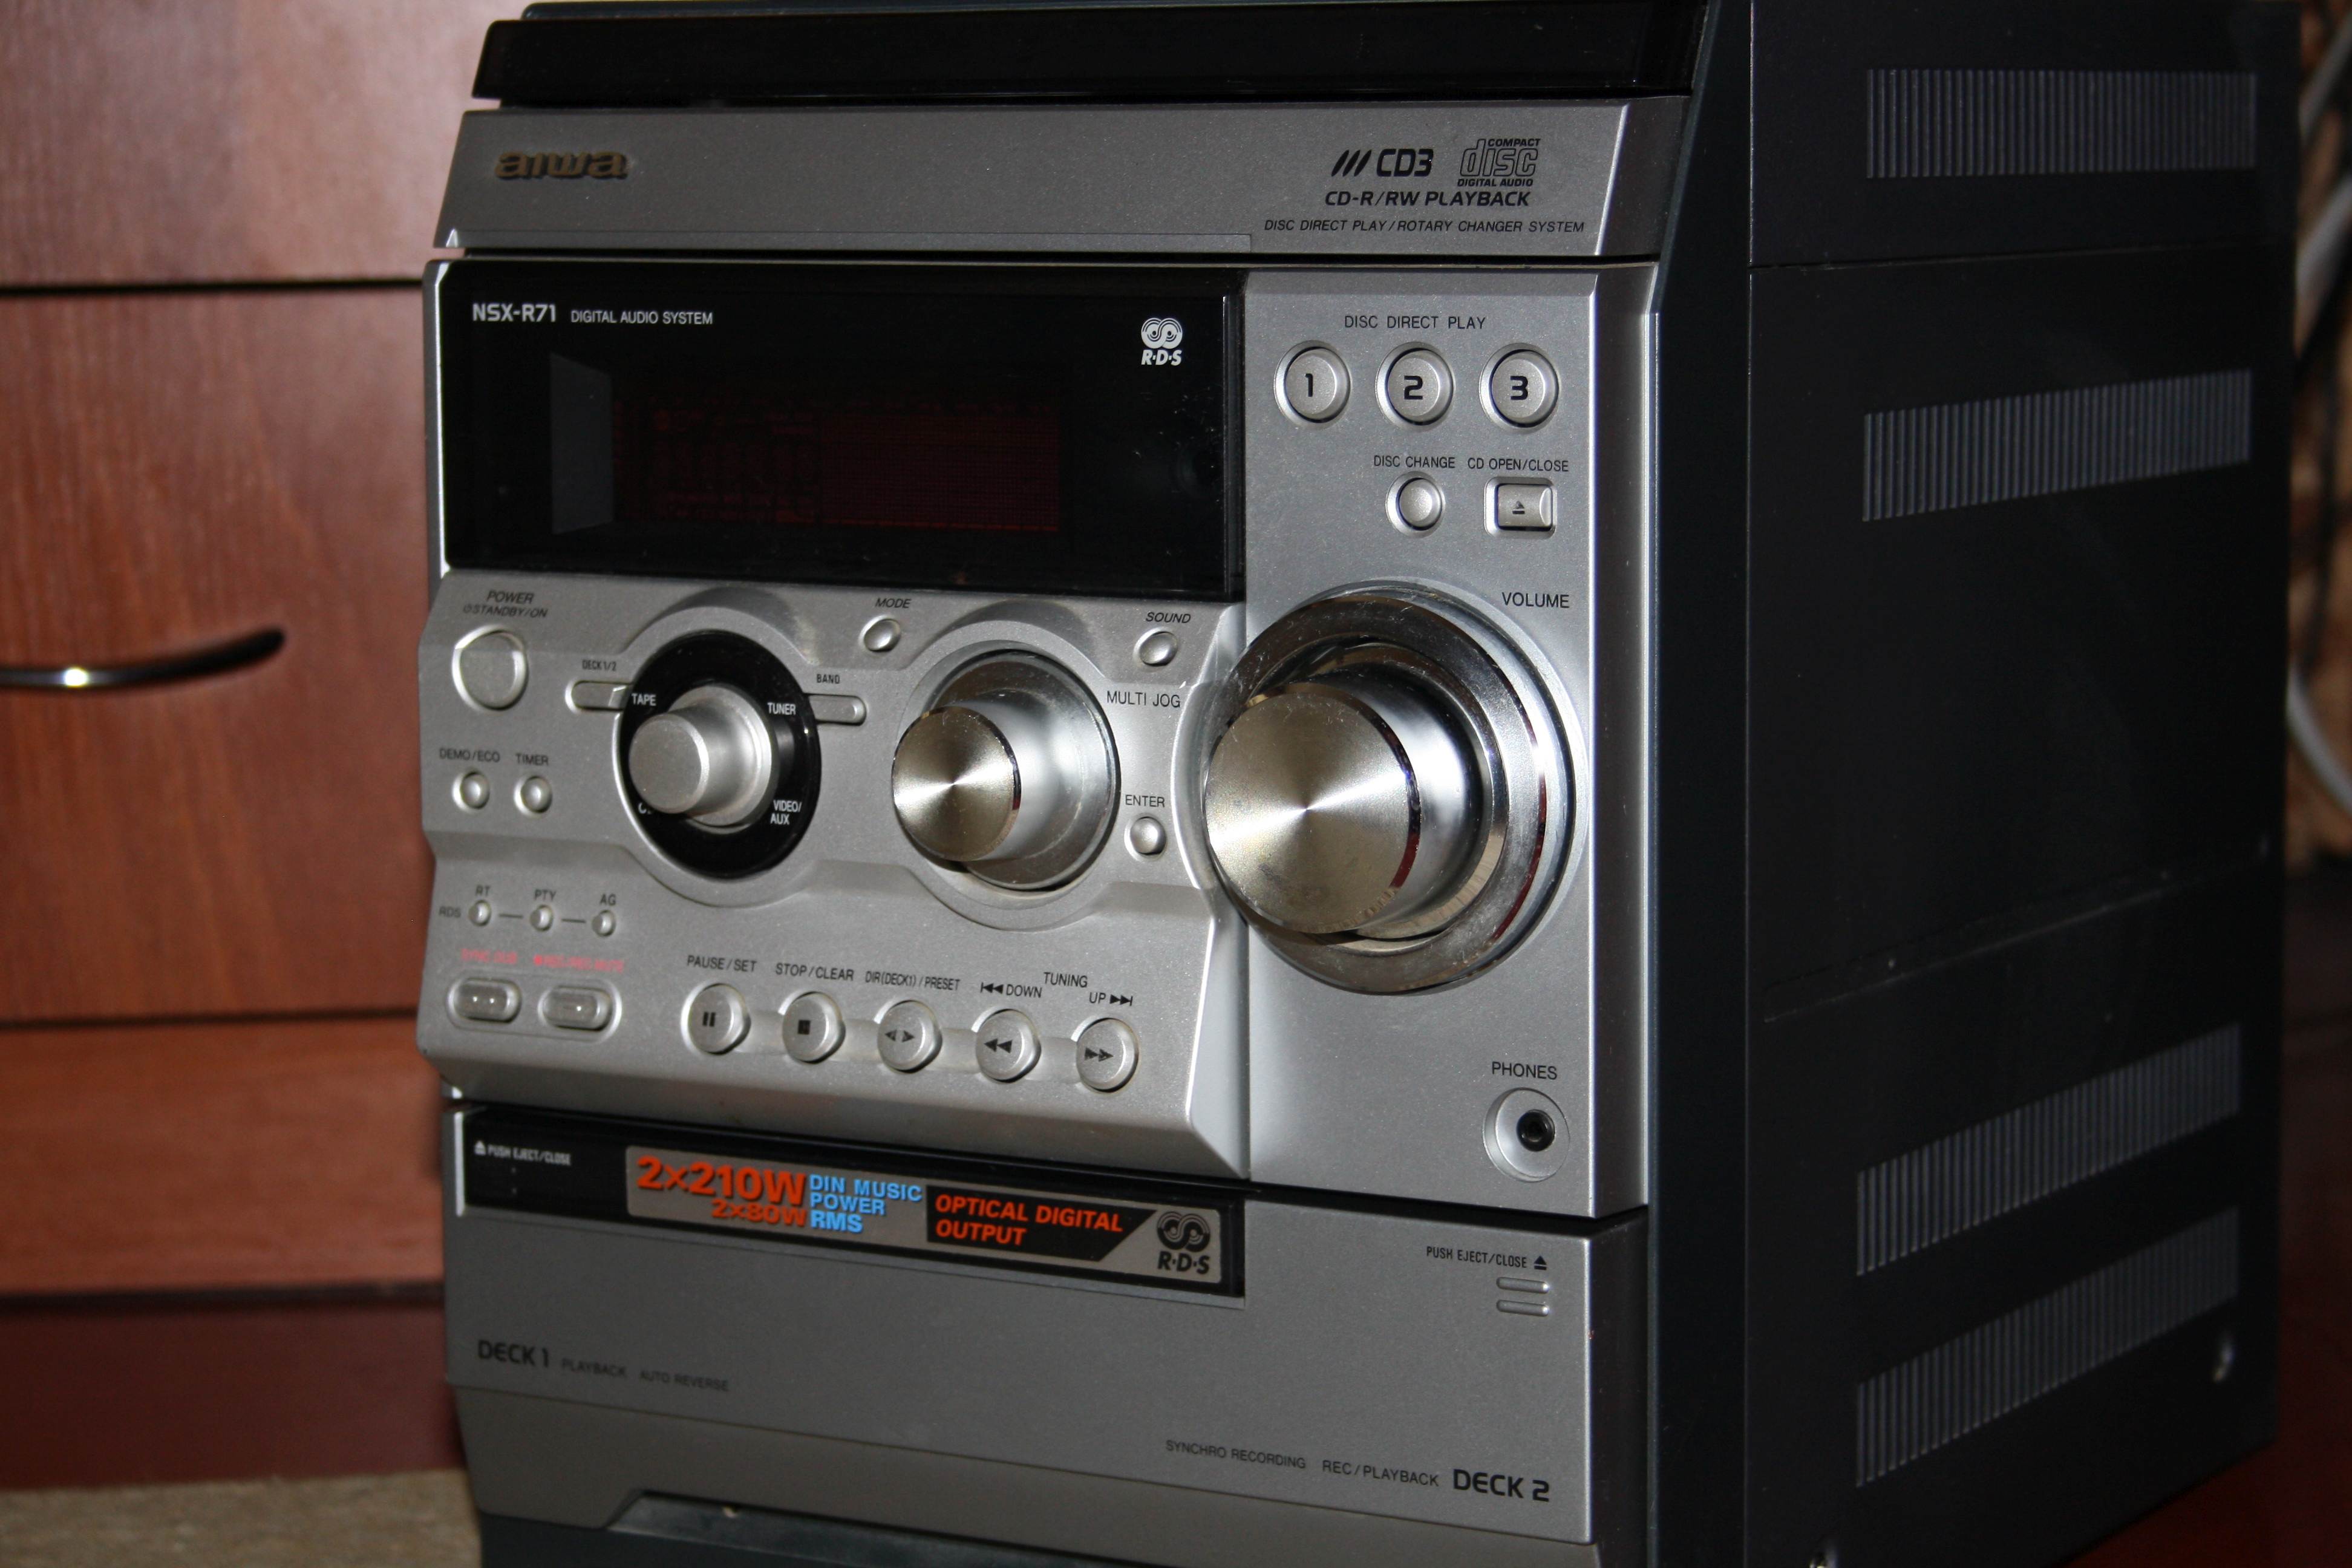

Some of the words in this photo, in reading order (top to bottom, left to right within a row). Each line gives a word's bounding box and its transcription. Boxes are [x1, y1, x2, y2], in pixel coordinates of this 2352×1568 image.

[1486, 138, 1540, 147] COMPACT
[1376, 148, 1434, 177] CD3
[1459, 138, 1540, 177] disc
[494, 151, 629, 180] aiwa
[1457, 178, 1497, 187] DIGITAL
[1500, 178, 1534, 187] AUDIO
[1324, 191, 1419, 206] CD-R/RW
[1424, 191, 1531, 206] PLAYBACK
[1264, 220, 1295, 231] DISC
[1299, 220, 1347, 231] DIRECT
[1457, 220, 1523, 232] CHANGER
[1527, 221, 1585, 233] SYSTEM
[472, 303, 557, 322] NSX-R71
[570, 310, 617, 323] DIGITAL
[620, 310, 659, 324] AUDIO
[662, 312, 713, 325] SYSTEM
[1344, 315, 1378, 329] DISC
[1387, 316, 1439, 330] DIRECT
[1448, 316, 1486, 330] PLAY
[1304, 373, 1313, 397] 1
[1403, 375, 1423, 400] 2
[1510, 376, 1528, 400] 3
[1373, 455, 1400, 468] DISC
[1405, 456, 1455, 469] CHANGE
[1468, 457, 1485, 470] CD
[1489, 457, 1569, 472] OPEN/CLOSE
[486, 590, 534, 604] POWER
[875, 597, 912, 609] MODE
[1501, 592, 1570, 608] VOLUME
[1146, 612, 1191, 624] SOUND
[816, 673, 840, 685] BAND
[631, 693, 657, 707] TAPE
[1106, 690, 1147, 705] MULTI
[1152, 693, 1181, 707] JOG
[768, 702, 797, 716] TUNER
[440, 748, 501, 763] DEMO/ECO
[515, 753, 549, 766] TIMER
[773, 800, 802, 813] VIDEO/
[1125, 794, 1165, 808] ENTER
[770, 812, 790, 825] AUX
[475, 885, 491, 897] RT
[534, 889, 556, 901] PTY
[599, 893, 617, 906] AG
[439, 906, 461, 919] RDS
[687, 955, 757, 973] PAUSE/SET
[775, 962, 854, 981] STOP/CLEAR
[1043, 971, 1089, 988] TUNING
[1005, 984, 1042, 999] DOWN
[1088, 991, 1107, 1004] UP
[1491, 1061, 1558, 1080] PHONES
[809, 1173, 846, 1194] DIN
[853, 1178, 923, 1202] MUSIC
[810, 1192, 886, 1216] POWER
[809, 1209, 864, 1233] RMS
[935, 1194, 1029, 1223] OPTICAL
[1034, 1204, 1123, 1233] DIGITAL
[935, 1220, 1027, 1247] OUTPUT
[1426, 1246, 1452, 1259] PUSH
[1457, 1250, 1527, 1268] EJECT/CLOSE
[478, 1341, 535, 1367] DECK
[561, 1357, 626, 1378] PLAYBACK
[639, 1370, 670, 1383] AUTO
[674, 1373, 729, 1392] REVERSE
[1166, 1440, 1227, 1458] SYNCHRO
[1231, 1446, 1306, 1469] RECORDING
[1323, 1459, 1439, 1487] REC/PLAYBACK
[1453, 1468, 1524, 1499] DECK
[1532, 1480, 1550, 1501] 2
